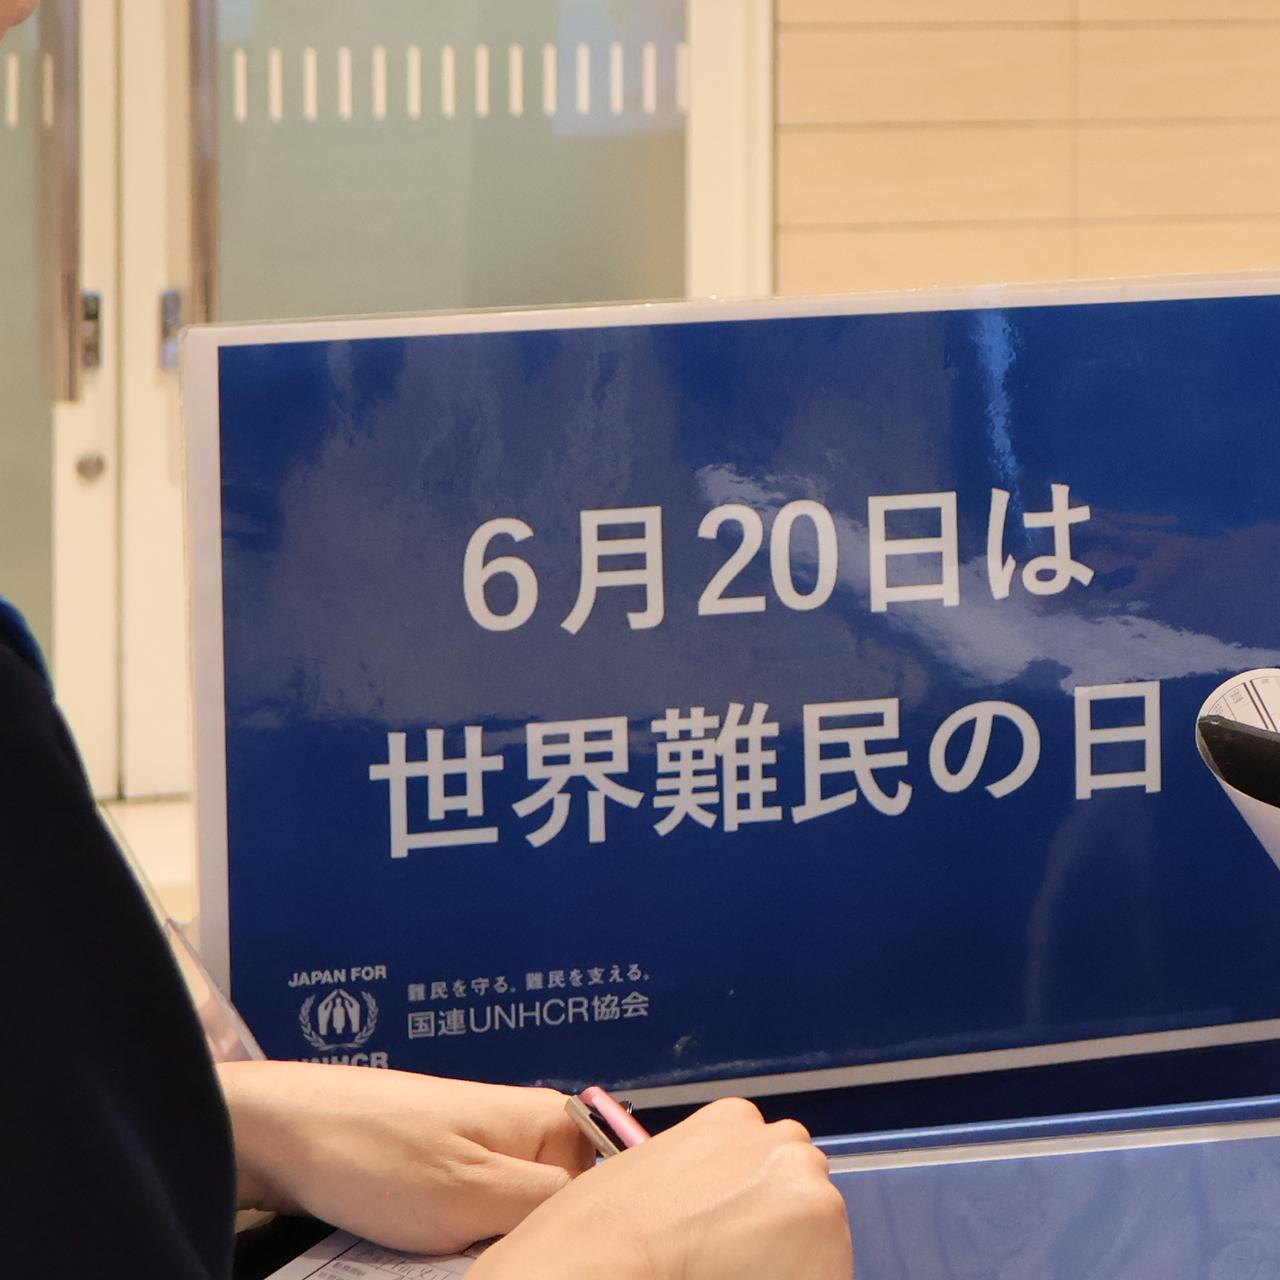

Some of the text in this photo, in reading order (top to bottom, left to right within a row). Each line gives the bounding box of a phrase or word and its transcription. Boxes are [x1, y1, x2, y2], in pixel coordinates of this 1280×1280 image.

[462, 482, 1096, 634] 6月20日は
[369, 681, 1163, 859] 世界難民の日
[288, 965, 387, 988] JAPAN FOR
[408, 991, 649, 1039] 国連UNHCR協会
